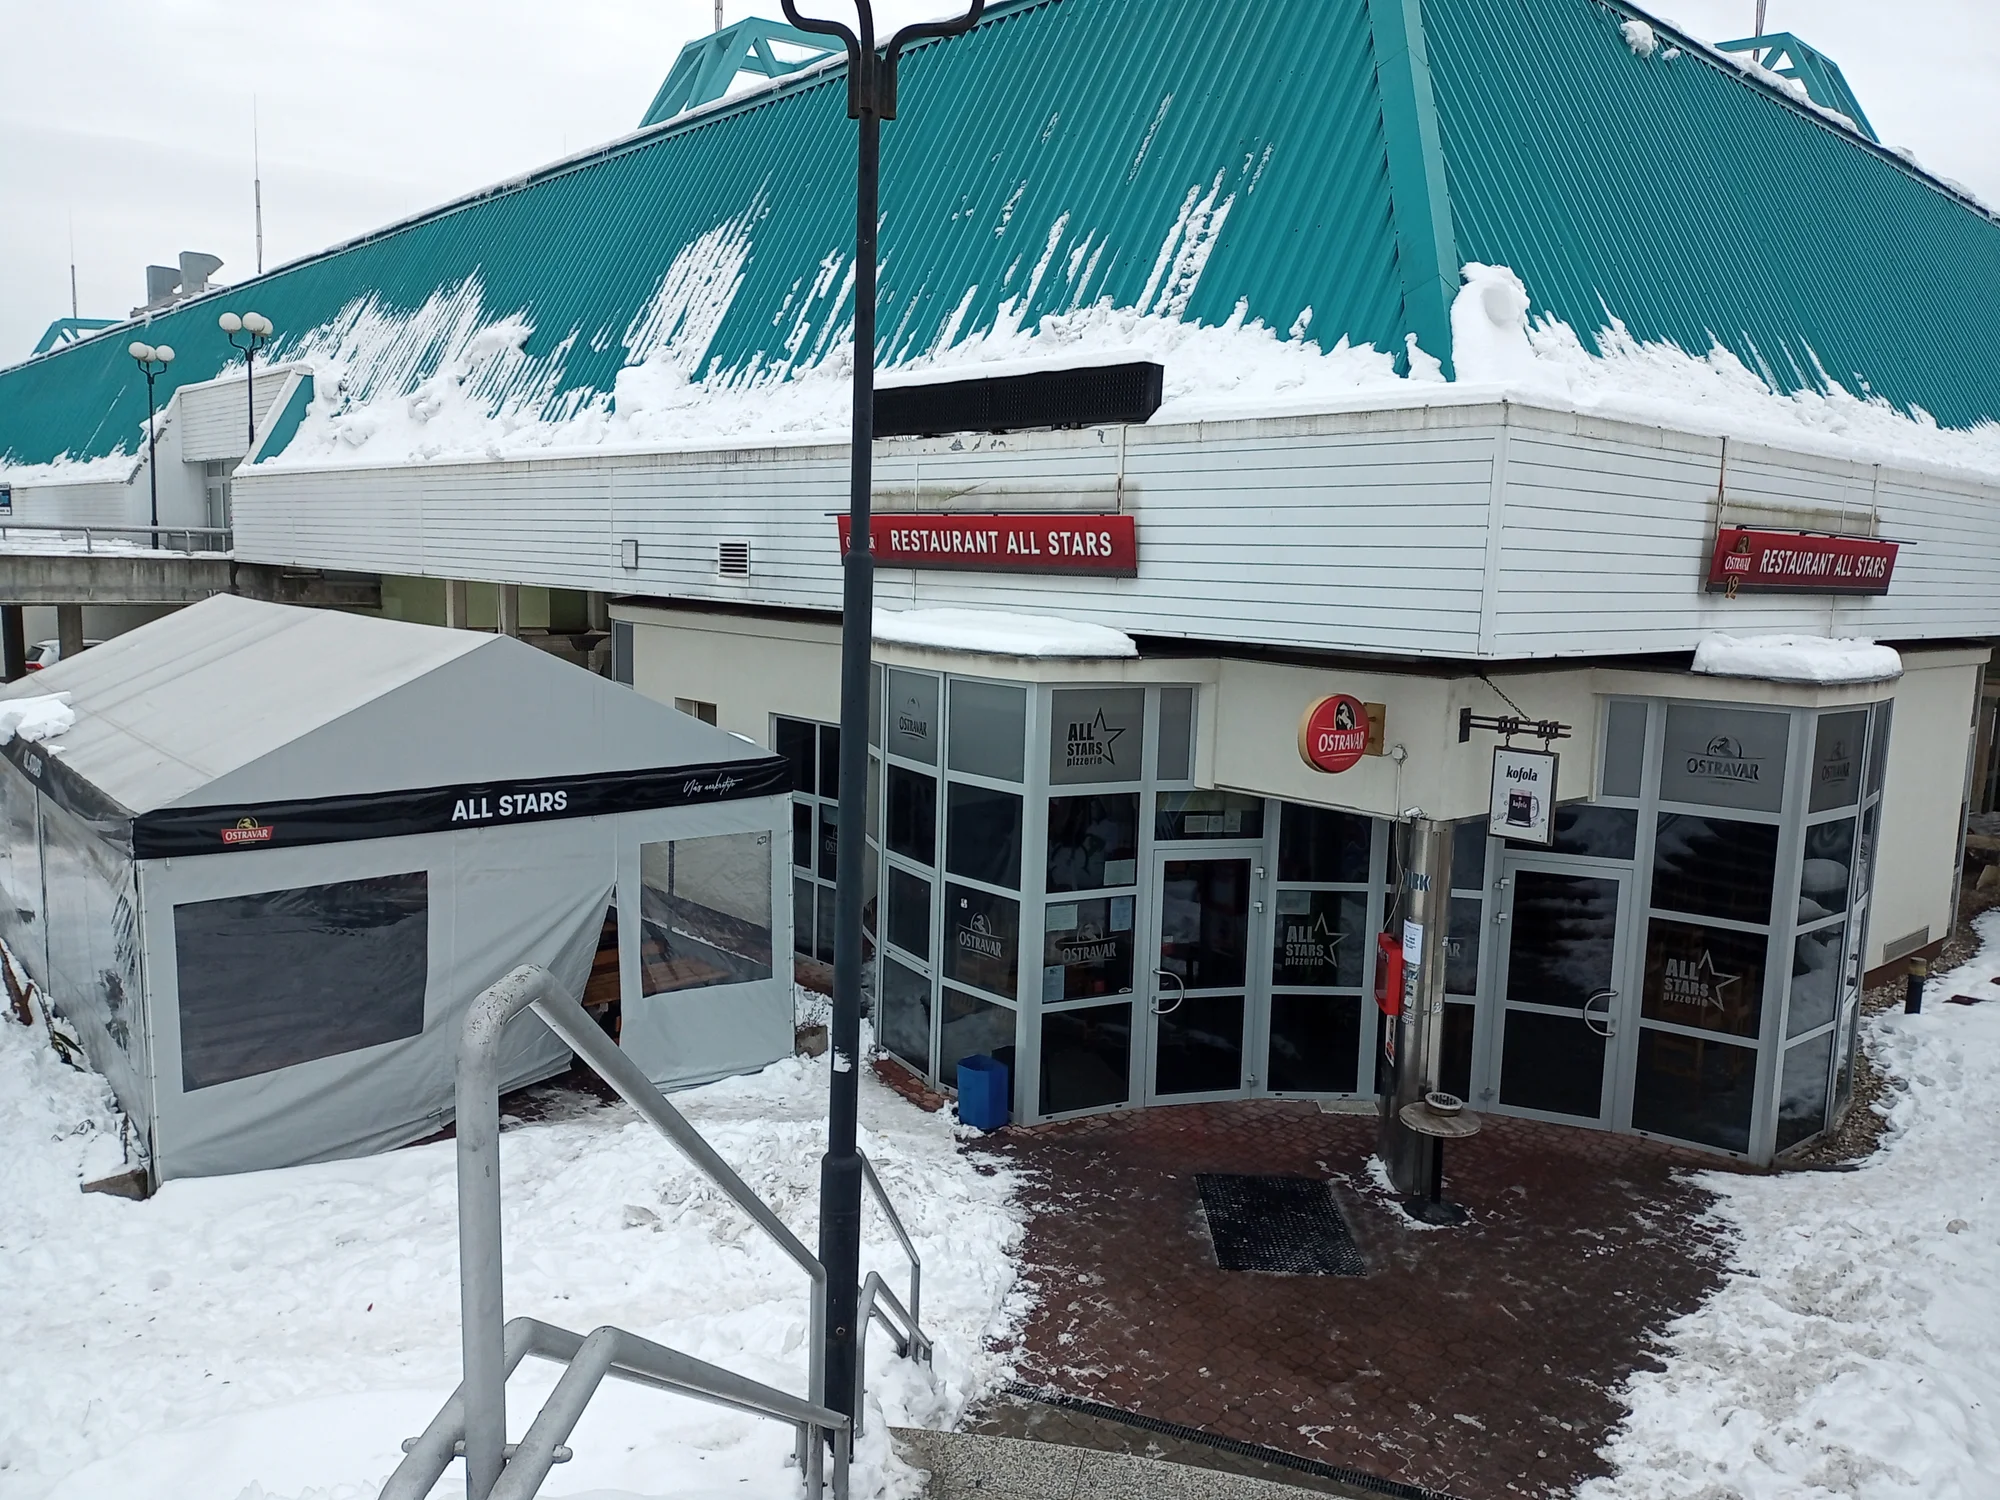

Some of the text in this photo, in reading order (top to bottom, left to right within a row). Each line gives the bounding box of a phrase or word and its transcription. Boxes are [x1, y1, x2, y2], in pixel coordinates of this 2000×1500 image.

[891, 529, 999, 554] RESTAURANT
[1006, 531, 1041, 555] ALL
[1048, 531, 1113, 556] STARS
[1759, 549, 1888, 578] RESTAURANT ALL STARS
[899, 716, 927, 737] OSTRAVAR
[1067, 723, 1094, 741] ALL
[1066, 742, 1103, 757] STARS
[1318, 731, 1365, 753] OSTRAVAR
[1505, 765, 1538, 783] kofola
[1686, 757, 1760, 781] OSTRAVAR
[452, 790, 568, 822] ALL STARS
[225, 828, 268, 842] OSTRAVAR
[959, 931, 1002, 958] OSTRAVAR
[1286, 925, 1315, 943] ALL
[1062, 942, 1117, 963] OSTRAVAR
[1285, 944, 1324, 957] STARS
[1665, 958, 1699, 981] ALL
[1664, 977, 1709, 997] STARS
